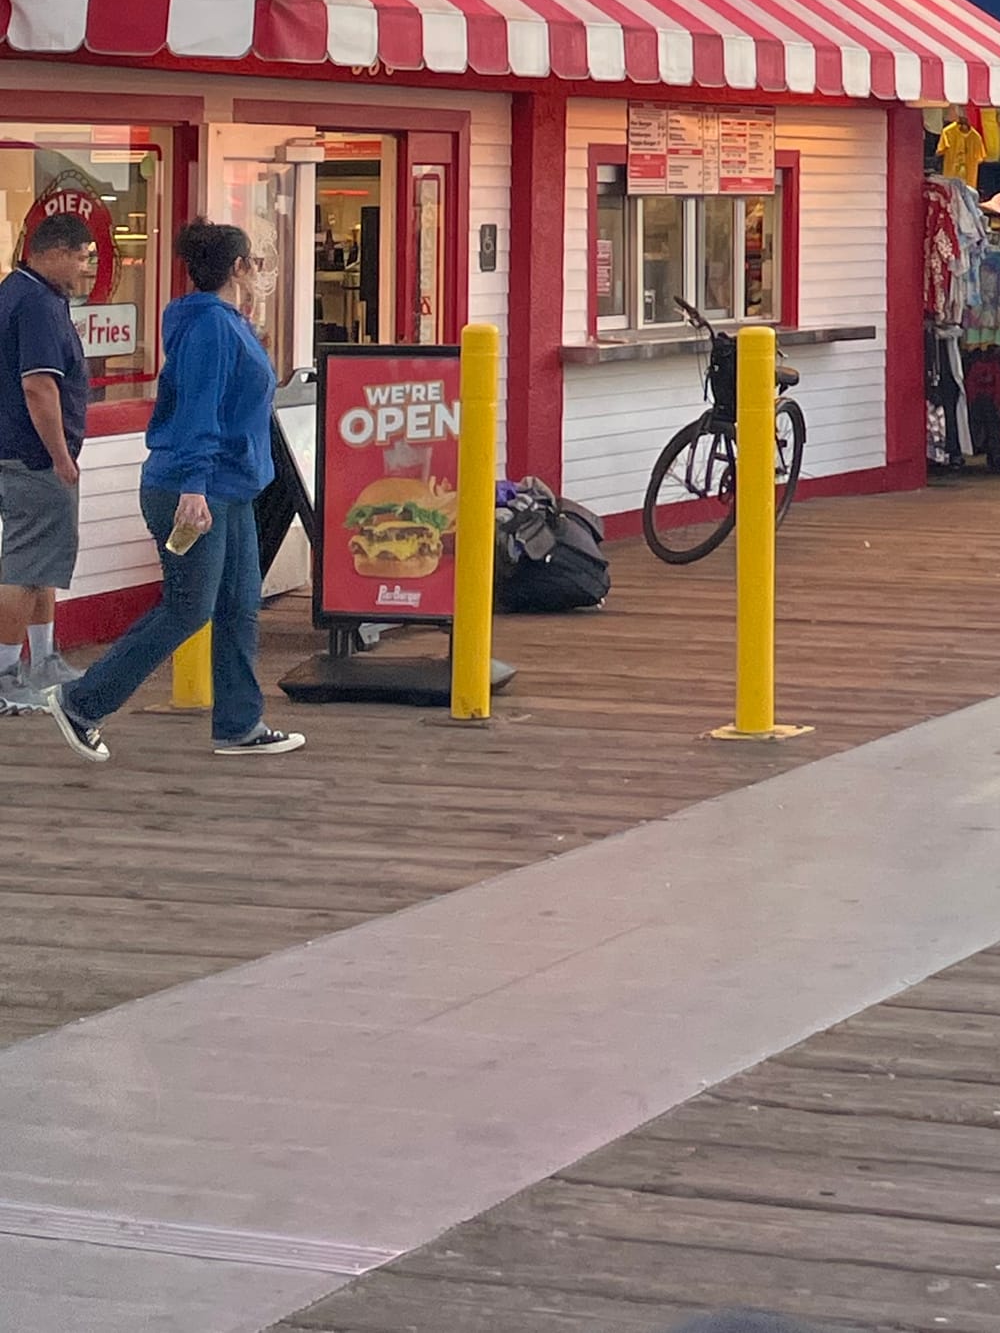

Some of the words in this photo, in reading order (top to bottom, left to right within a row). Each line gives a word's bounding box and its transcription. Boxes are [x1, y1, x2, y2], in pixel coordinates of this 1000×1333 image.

[44, 193, 93, 221] PIER
[88, 313, 131, 345] Fries
[365, 382, 441, 407] WE'RE
[340, 401, 461, 445] OPEN
